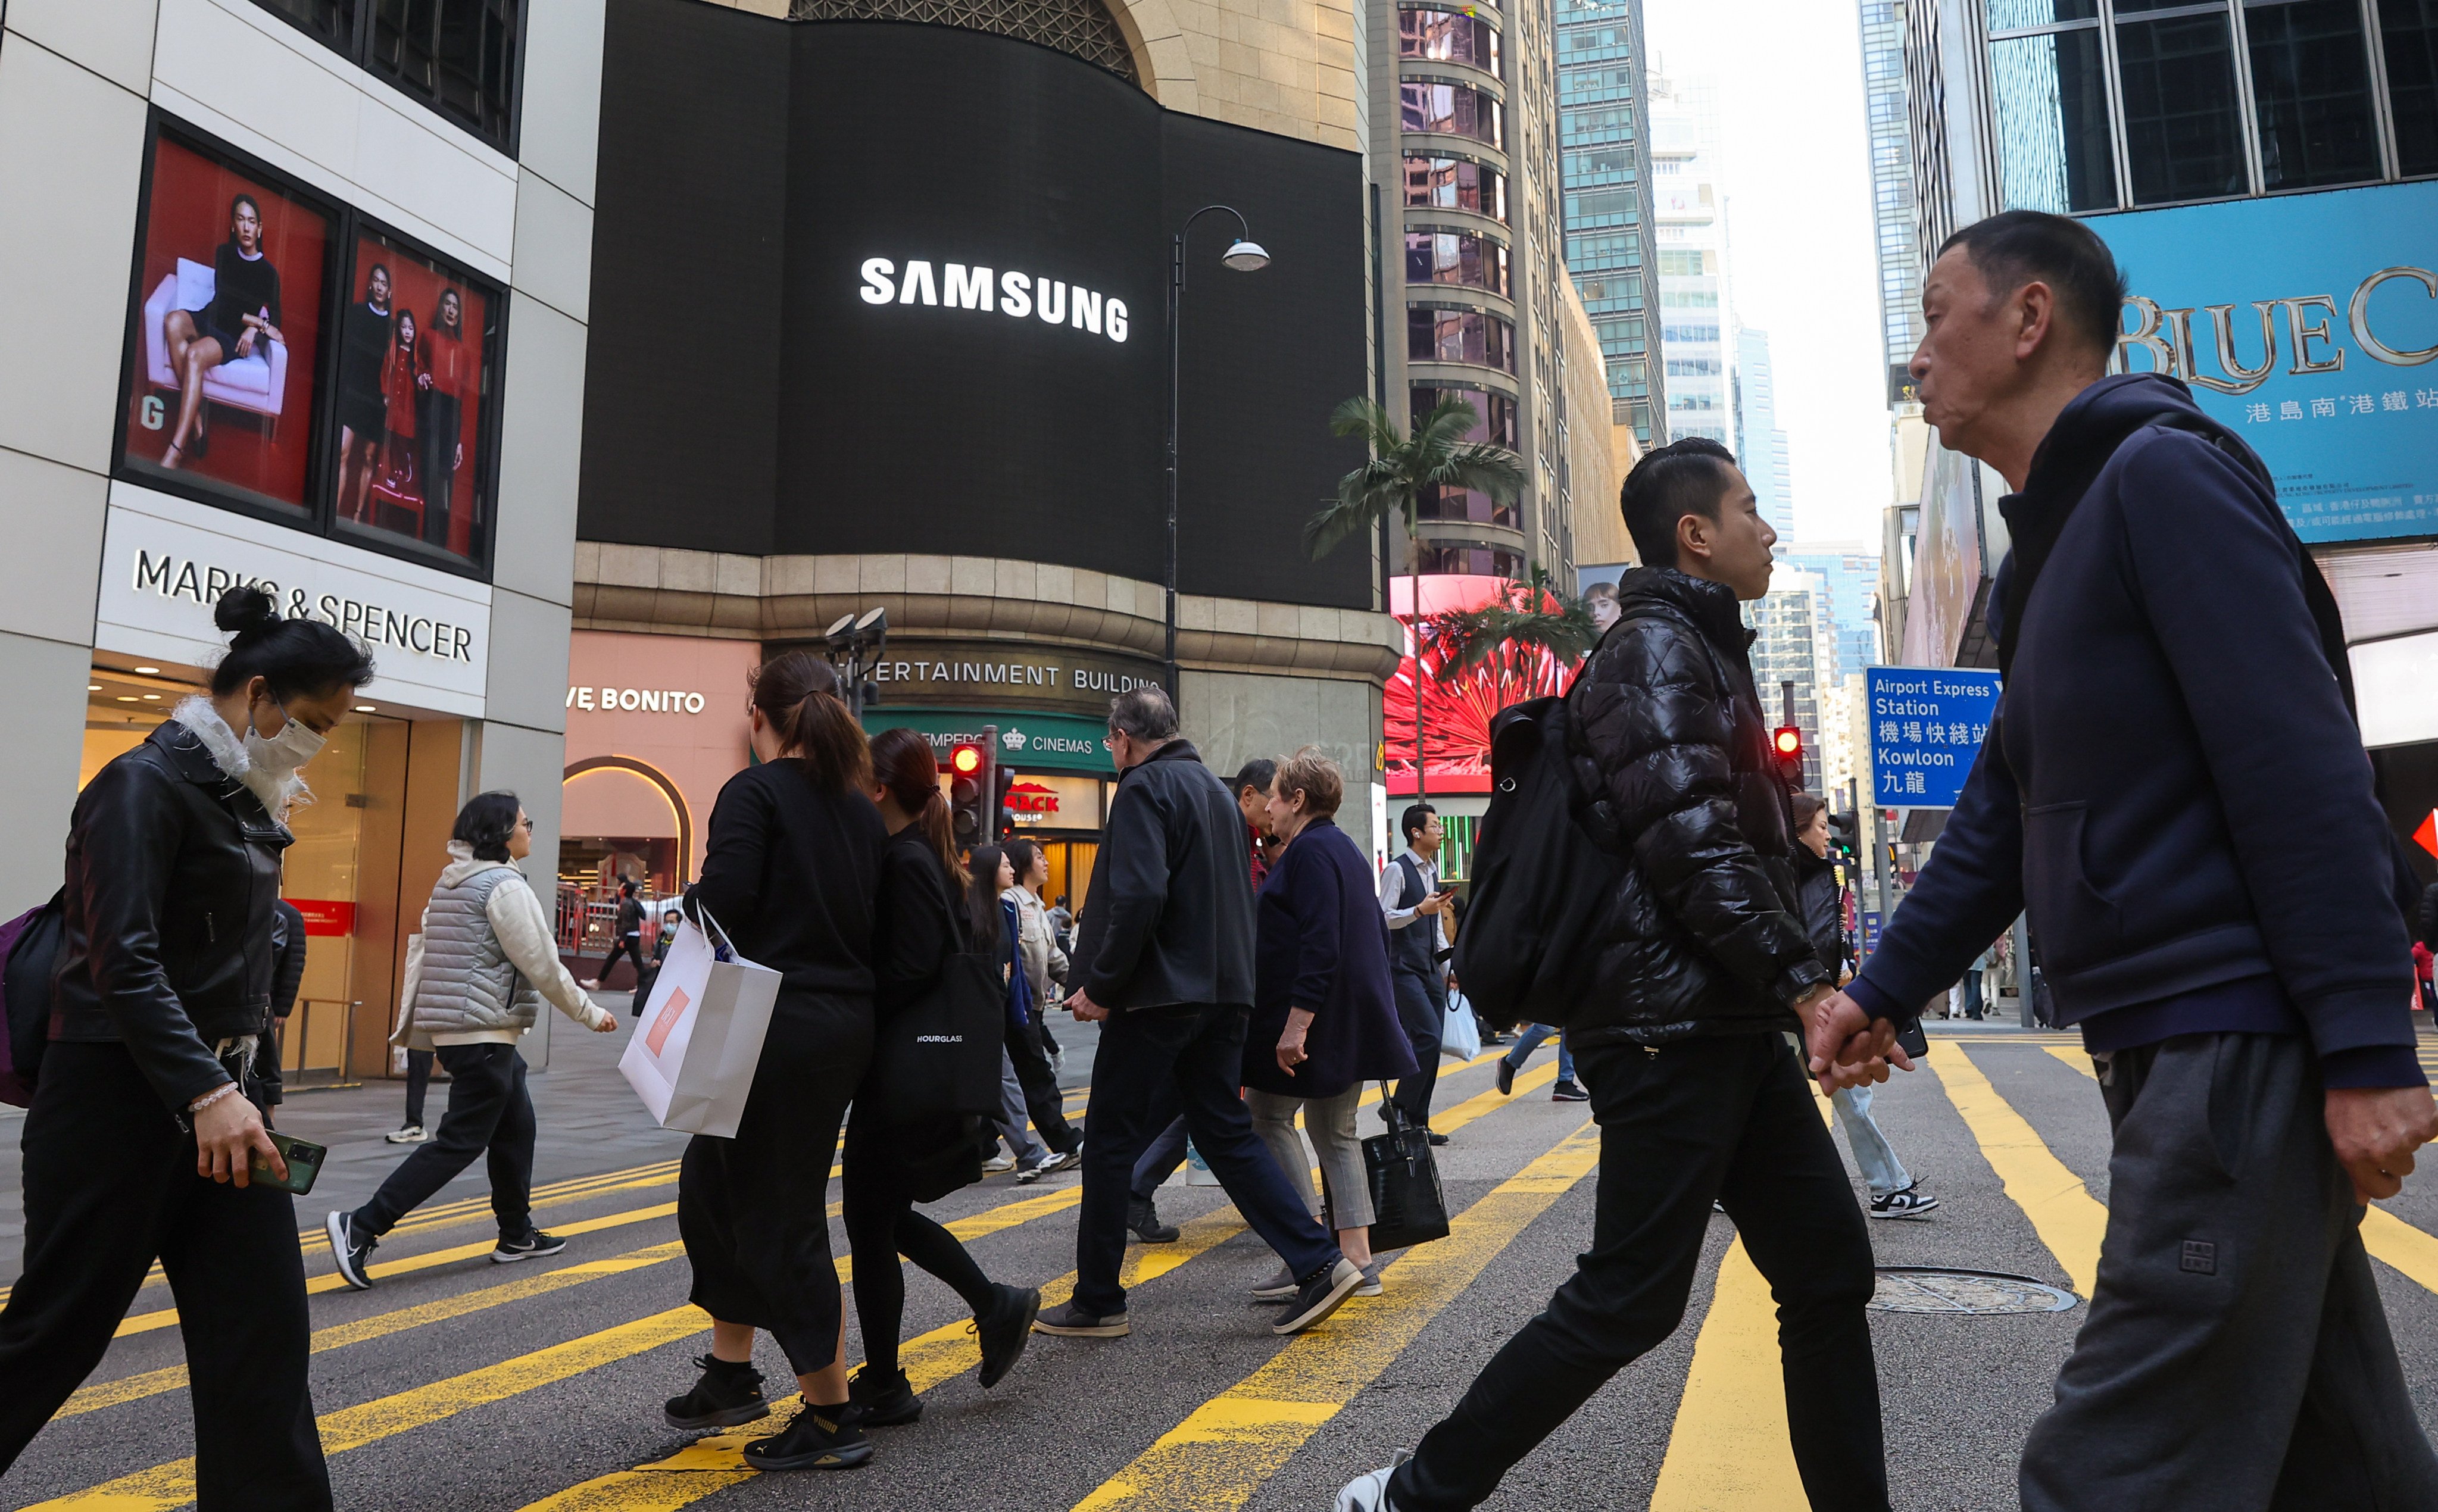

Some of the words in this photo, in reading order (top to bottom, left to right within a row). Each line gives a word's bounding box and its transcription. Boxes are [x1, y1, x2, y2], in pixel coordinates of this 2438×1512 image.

[860, 257, 1129, 343] SAMSUNG
[2106, 293, 2345, 395] BLUE
[141, 395, 165, 430] G
[284, 586, 310, 619] &
[317, 593, 472, 664] SPENCER
[838, 661, 1060, 686] ERTAINMENT
[601, 687, 706, 714] BONITO
[1875, 679, 1928, 696] Airport
[1933, 680, 1990, 698] Express
[1876, 698, 1939, 716] Station
[1032, 736, 1092, 754] CINEMAS
[1878, 748, 1955, 767] Kowloon
[1883, 770, 1927, 794] 九龍
[1012, 813, 1038, 822] OUSE
[916, 1035, 963, 1043] HOURGLASS
